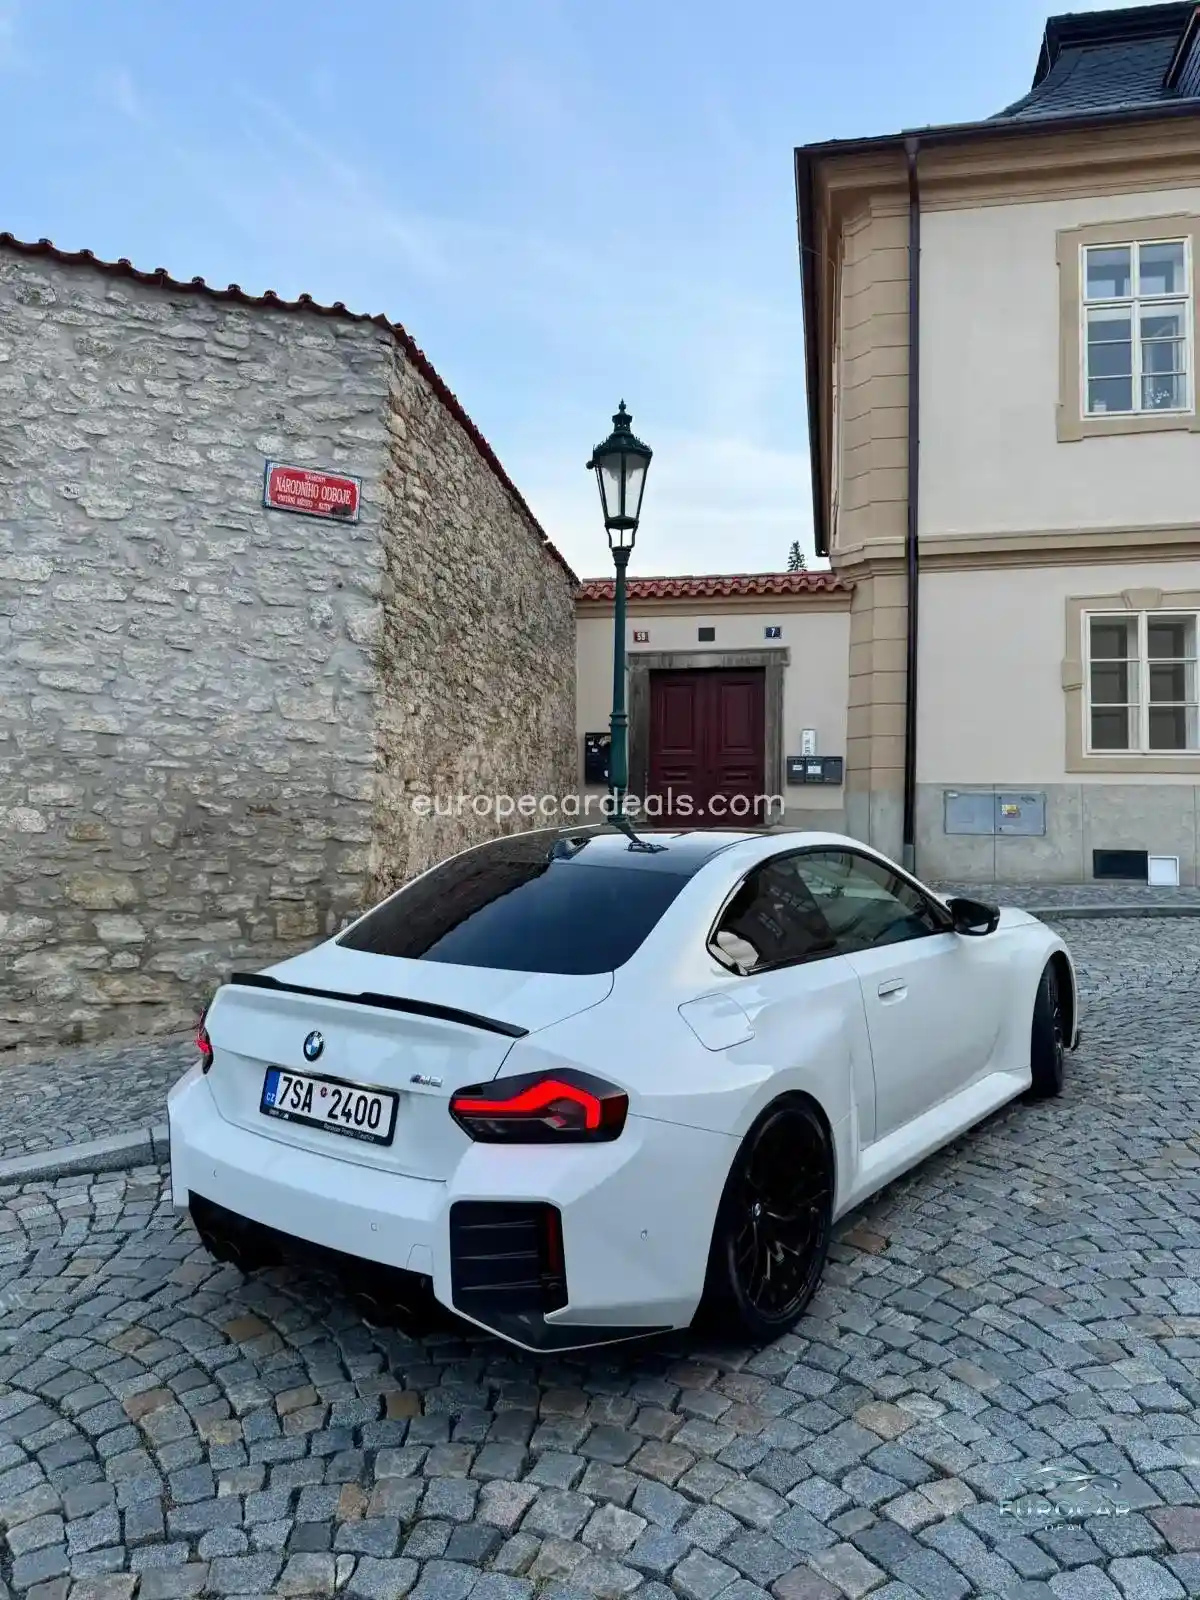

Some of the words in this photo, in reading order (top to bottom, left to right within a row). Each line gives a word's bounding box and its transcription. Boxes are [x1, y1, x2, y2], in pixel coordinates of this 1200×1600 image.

[275, 475, 319, 500] NÁRODNÍHO
[321, 486, 351, 504] ODBOJE
[266, 1092, 276, 1103] CZ
[279, 1076, 314, 1113] 7SA
[327, 1089, 382, 1129] 2400
